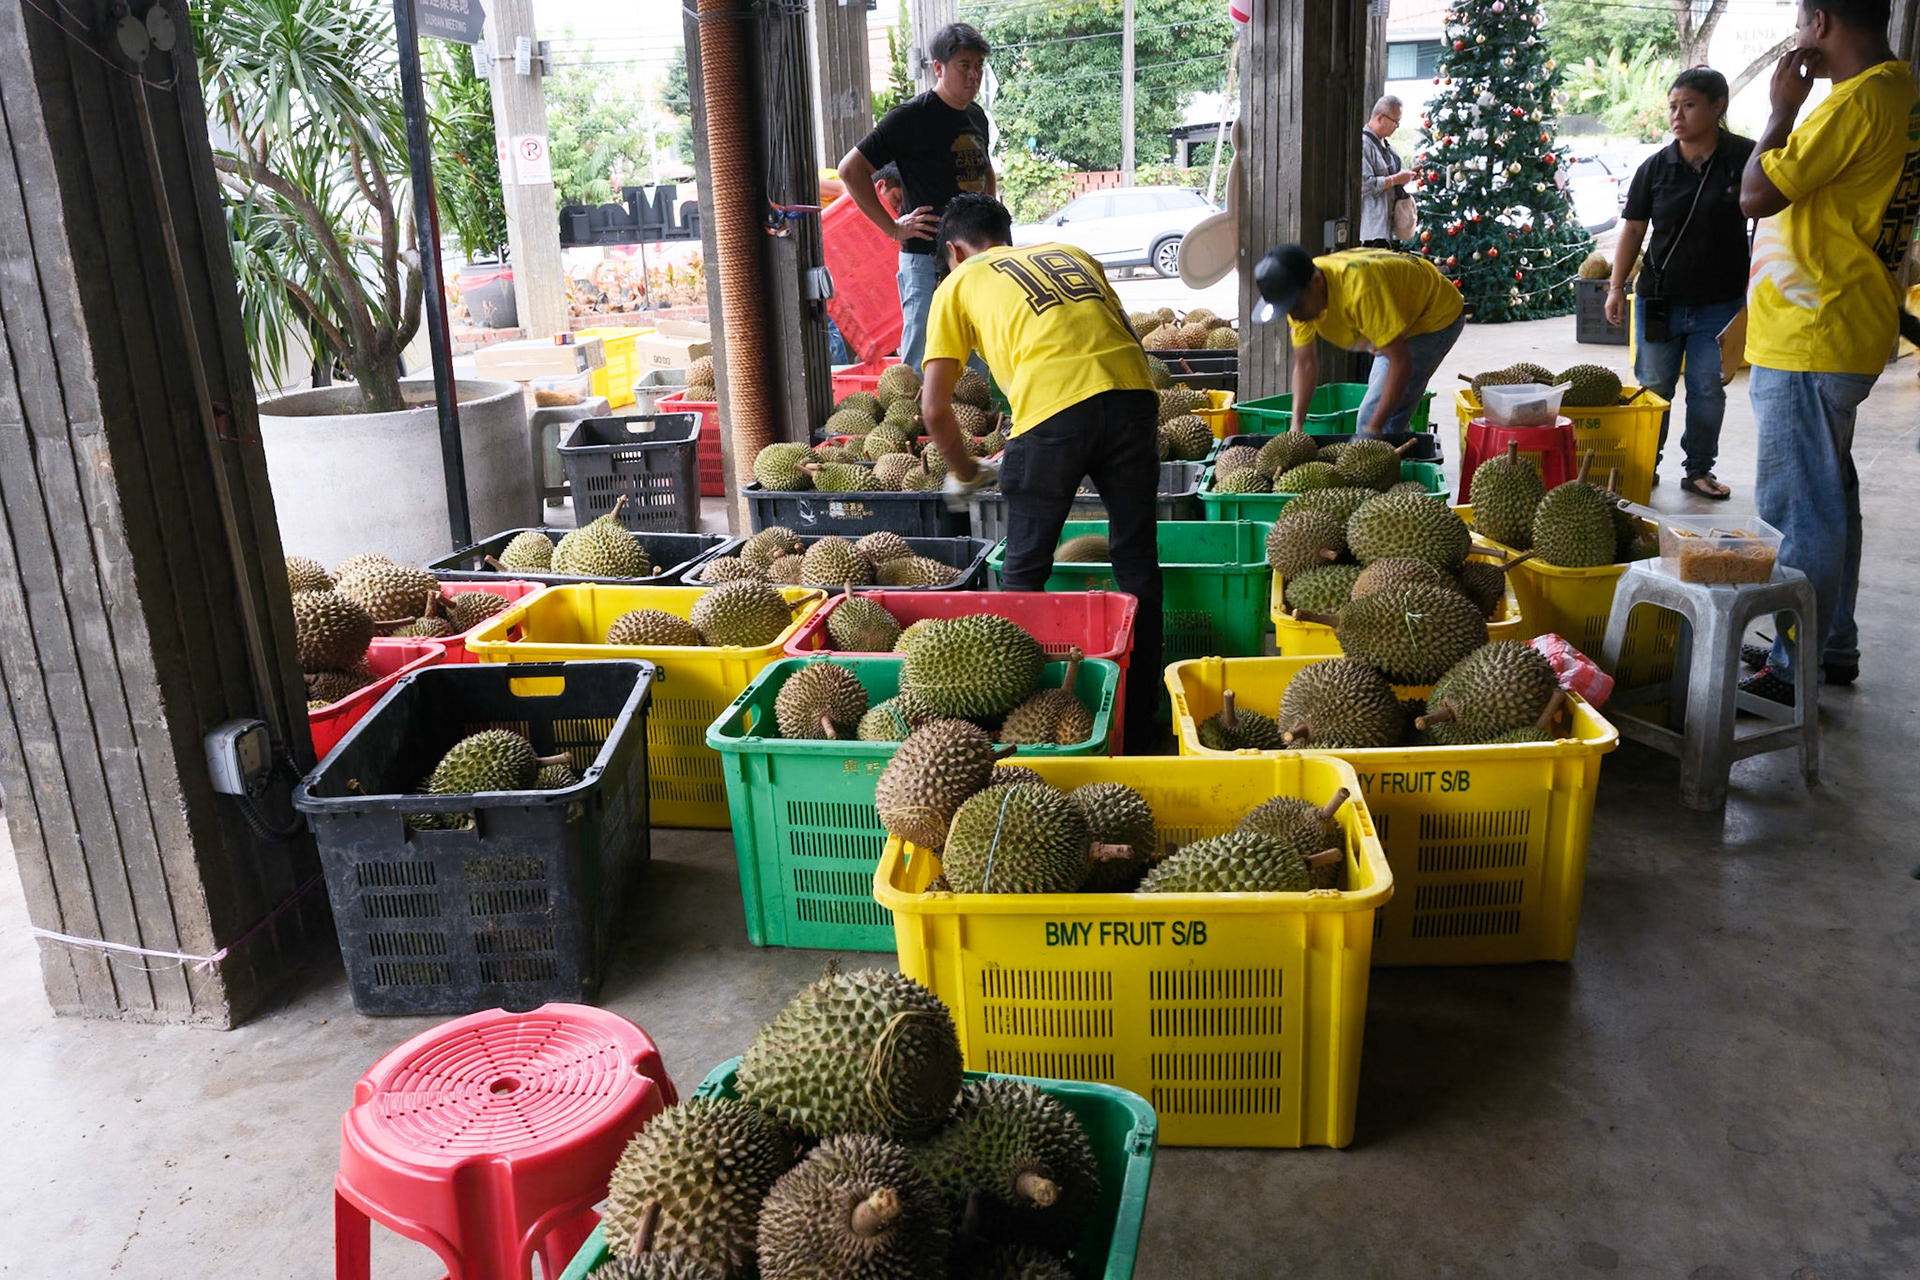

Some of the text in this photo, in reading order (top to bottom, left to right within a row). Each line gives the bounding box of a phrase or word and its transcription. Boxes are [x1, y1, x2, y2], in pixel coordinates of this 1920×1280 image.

[424, 12, 467, 33] DURIAN MEETING
[989, 249, 1106, 317] 18
[1380, 772, 1437, 794] FRUIT
[1440, 770, 1471, 793] S/B
[1045, 920, 1208, 947] BMY FRUIT S/B
